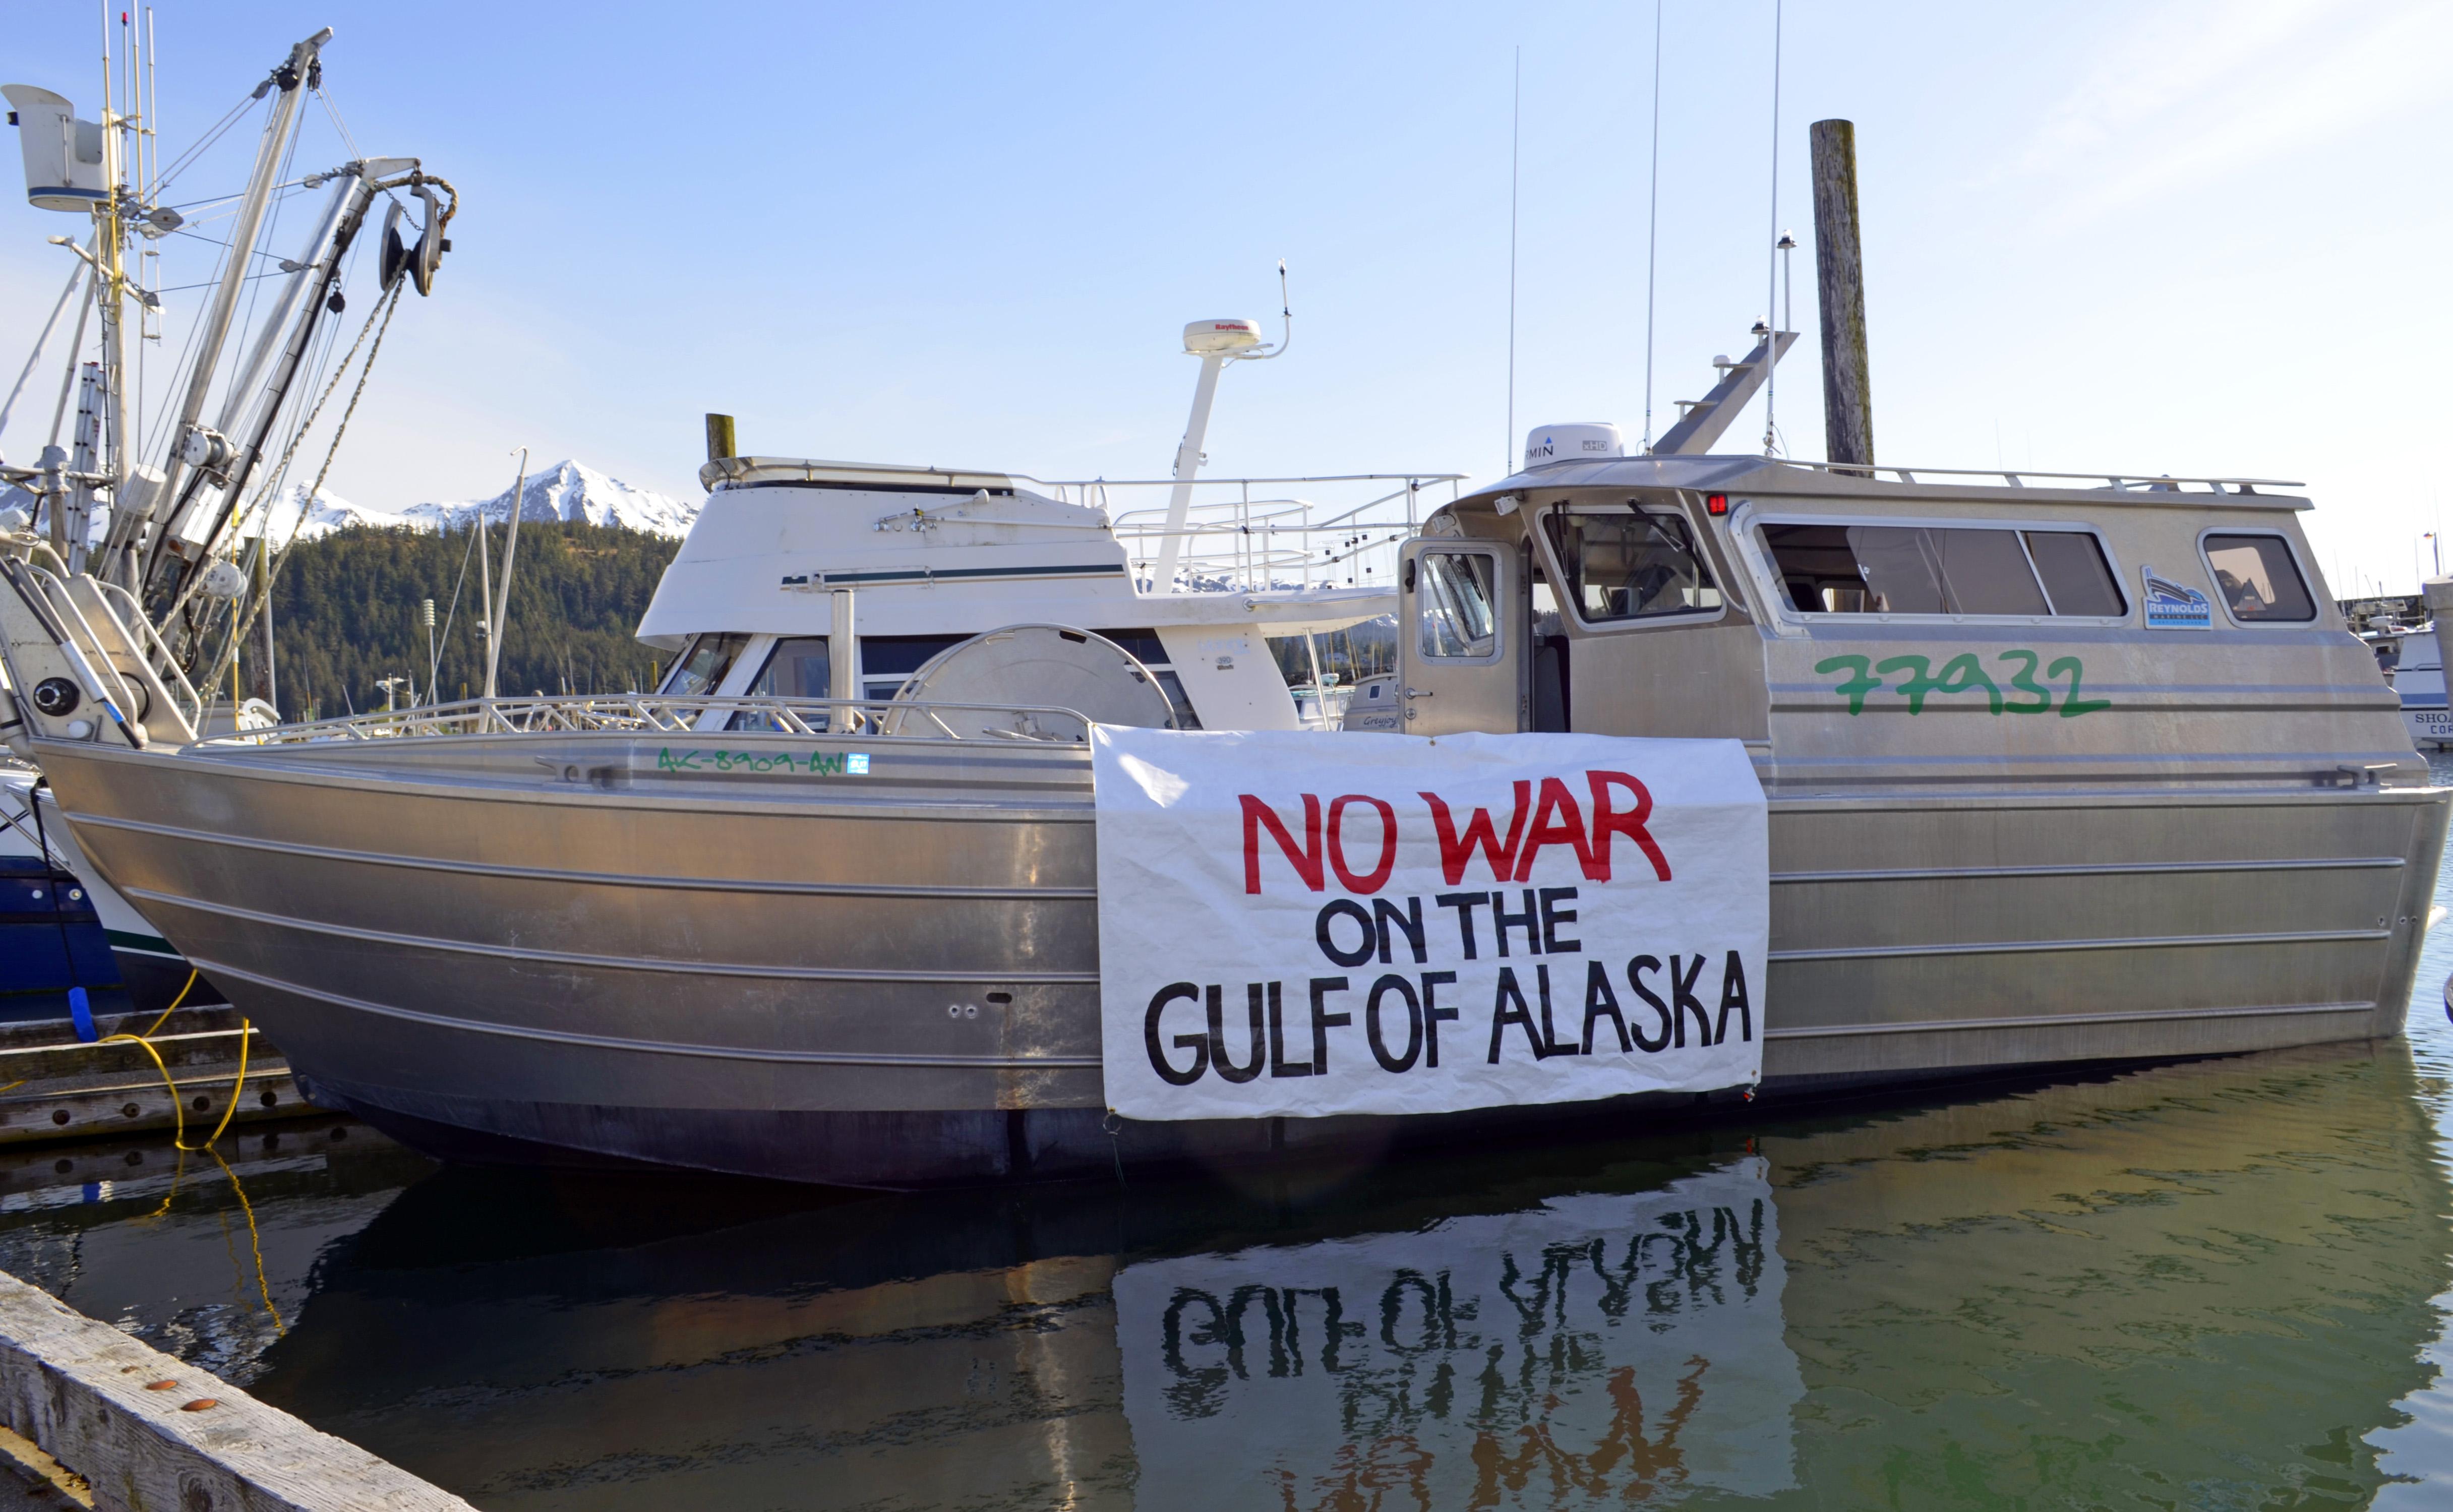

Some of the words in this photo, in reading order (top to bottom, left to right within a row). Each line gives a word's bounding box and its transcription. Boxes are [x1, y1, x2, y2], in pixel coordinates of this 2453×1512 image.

[1584, 441, 1607, 450] xHD
[2149, 603, 2207, 613] REYNOLDS
[1815, 649, 2111, 717] 77932
[1363, 715, 1397, 729] Greyjoy
[2415, 713, 2451, 723] SHO
[1238, 794, 1398, 894] NO
[1417, 770, 1672, 885] WAR
[1315, 896, 1427, 967] ON
[1436, 886, 1582, 960] THE
[1144, 976, 1352, 1086] GULF
[1365, 971, 1459, 1073] OF
[1487, 950, 1752, 1064] ALASKA
